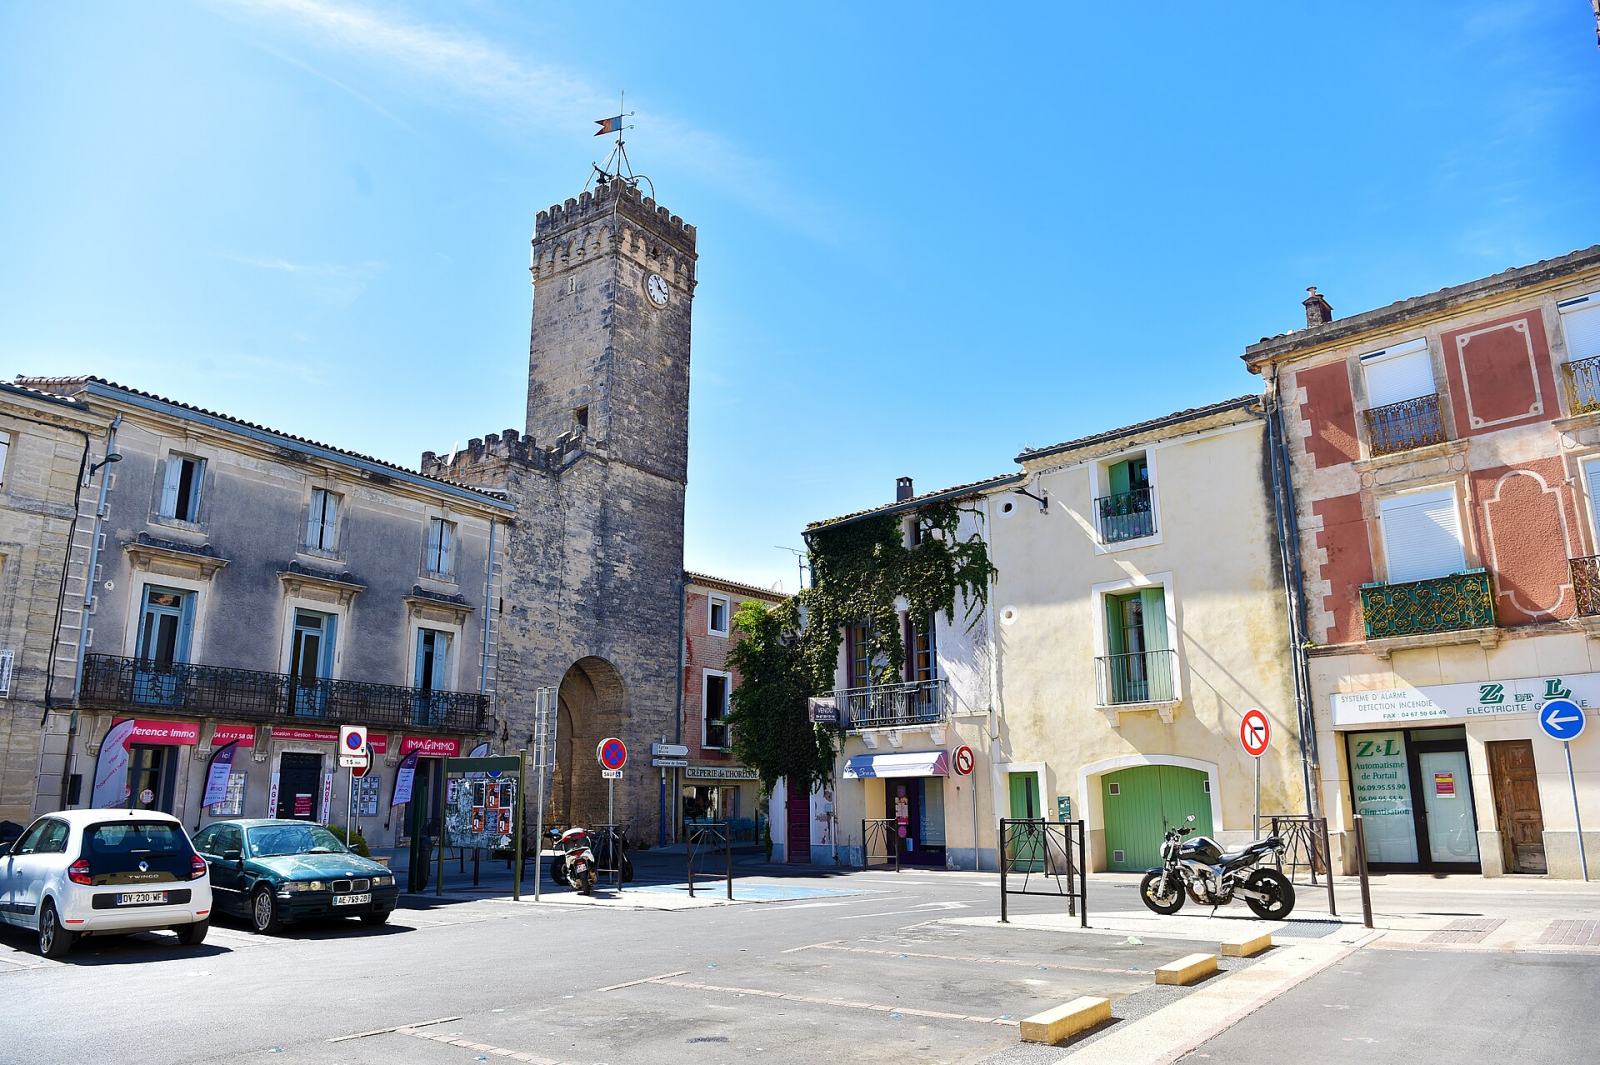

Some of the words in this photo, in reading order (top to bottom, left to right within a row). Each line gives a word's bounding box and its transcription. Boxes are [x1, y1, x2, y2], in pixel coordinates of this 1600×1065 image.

[1479, 683, 1504, 704] Z
[1543, 678, 1572, 700] L
[1341, 694, 1369, 703] SYSTEME
[1381, 691, 1407, 700] ALARME
[1358, 703, 1396, 712] DETECTION
[1399, 699, 1433, 709] INCENDIE
[1466, 703, 1528, 715] ELECTRICITE
[132, 726, 168, 737] ference
[1354, 761, 1405, 770] Automatisme
[1373, 771, 1397, 780] Portail
[1358, 807, 1410, 816] Climatisation
